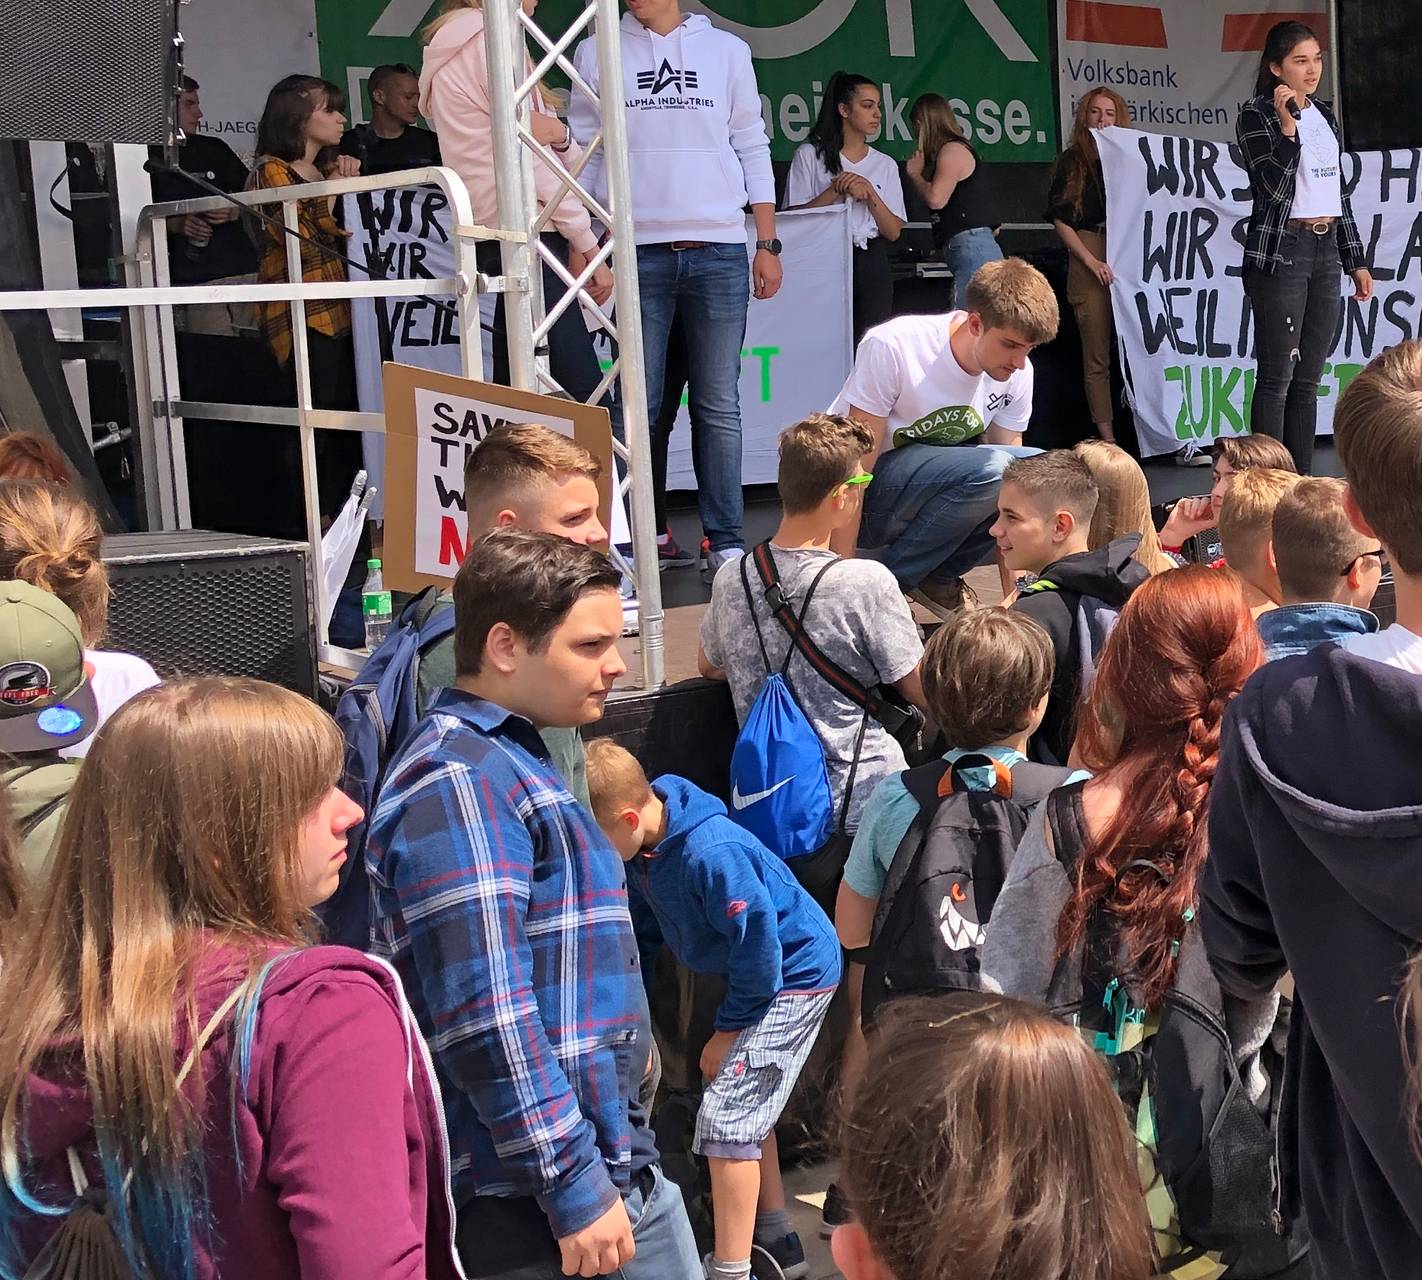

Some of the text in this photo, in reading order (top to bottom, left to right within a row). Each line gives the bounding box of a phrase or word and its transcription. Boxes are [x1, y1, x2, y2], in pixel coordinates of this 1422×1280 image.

[1067, 57, 1179, 88] Volksbank
[1128, 100, 1228, 124] ärkischen
[1139, 136, 1227, 199] WIR
[356, 188, 449, 243] WIR
[1143, 209, 1219, 283] WIR
[1134, 287, 1232, 358] WEIL
[431, 402, 518, 442] SAV
[898, 409, 961, 438] RIDAYS
